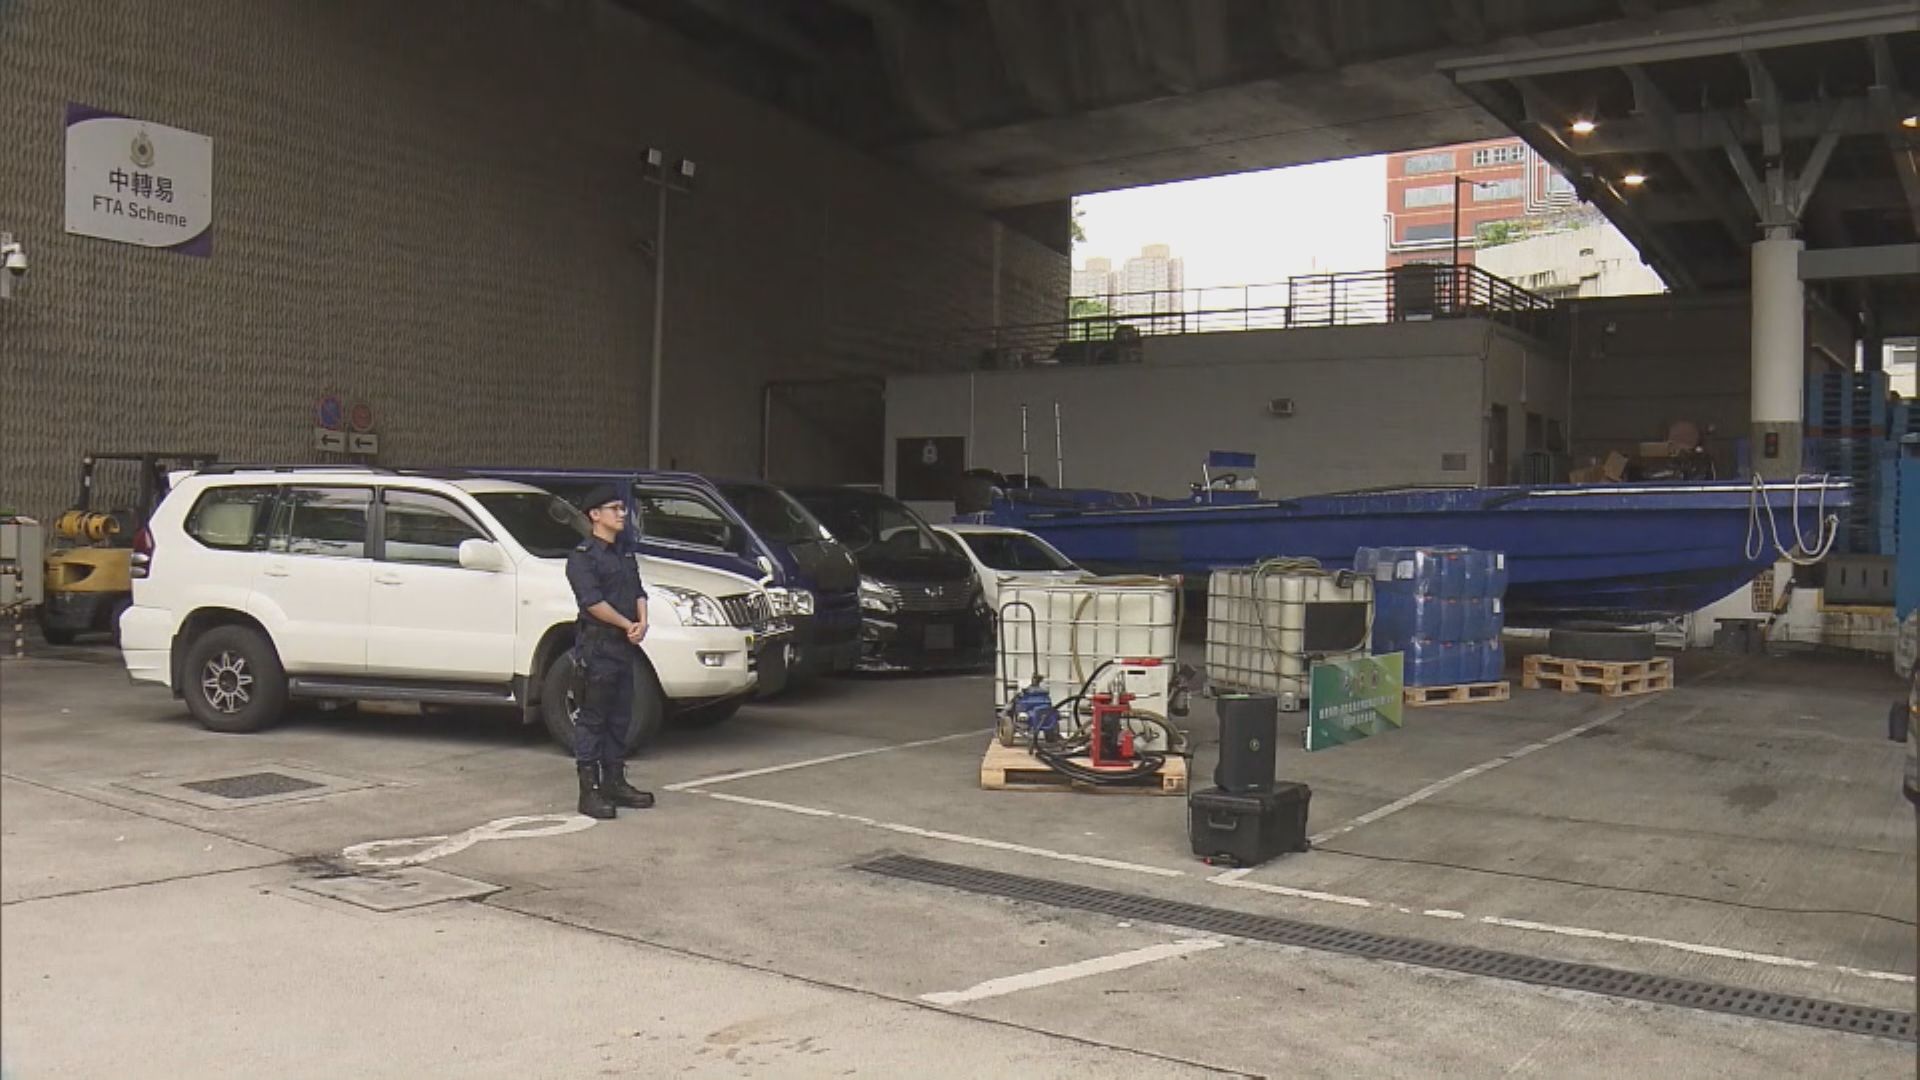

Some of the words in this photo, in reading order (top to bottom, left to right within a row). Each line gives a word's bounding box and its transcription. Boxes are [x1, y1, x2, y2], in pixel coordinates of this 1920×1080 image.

[109, 167, 174, 203] 中轉易
[93, 195, 124, 216] FTA
[128, 202, 187, 227] Scheme
